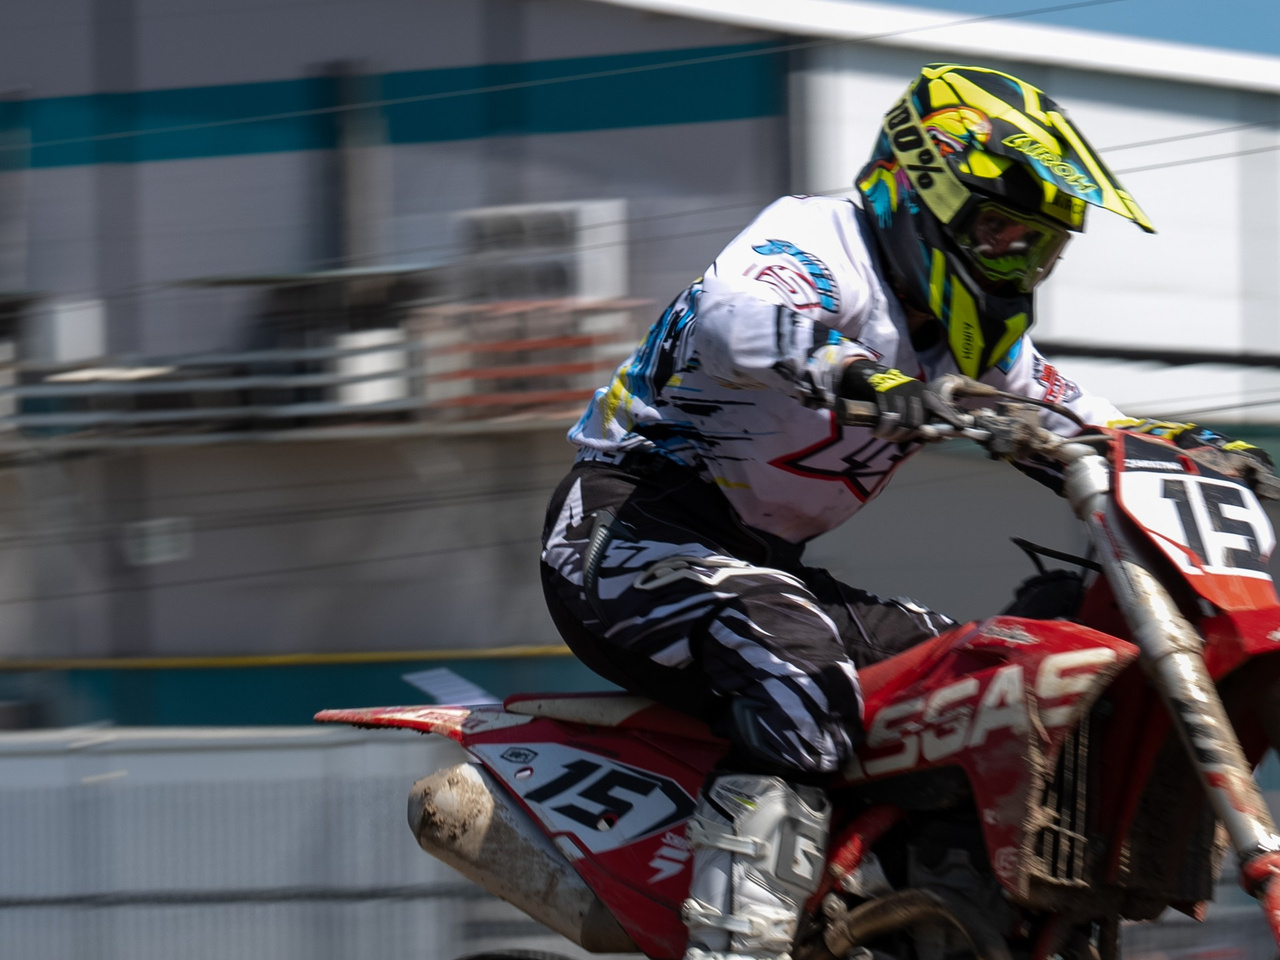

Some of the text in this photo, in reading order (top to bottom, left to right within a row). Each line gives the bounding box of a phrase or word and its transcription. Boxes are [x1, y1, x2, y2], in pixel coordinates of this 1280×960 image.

[1162, 479, 1264, 573] 15
[850, 648, 1117, 780] SGAS
[524, 759, 661, 831] 15
